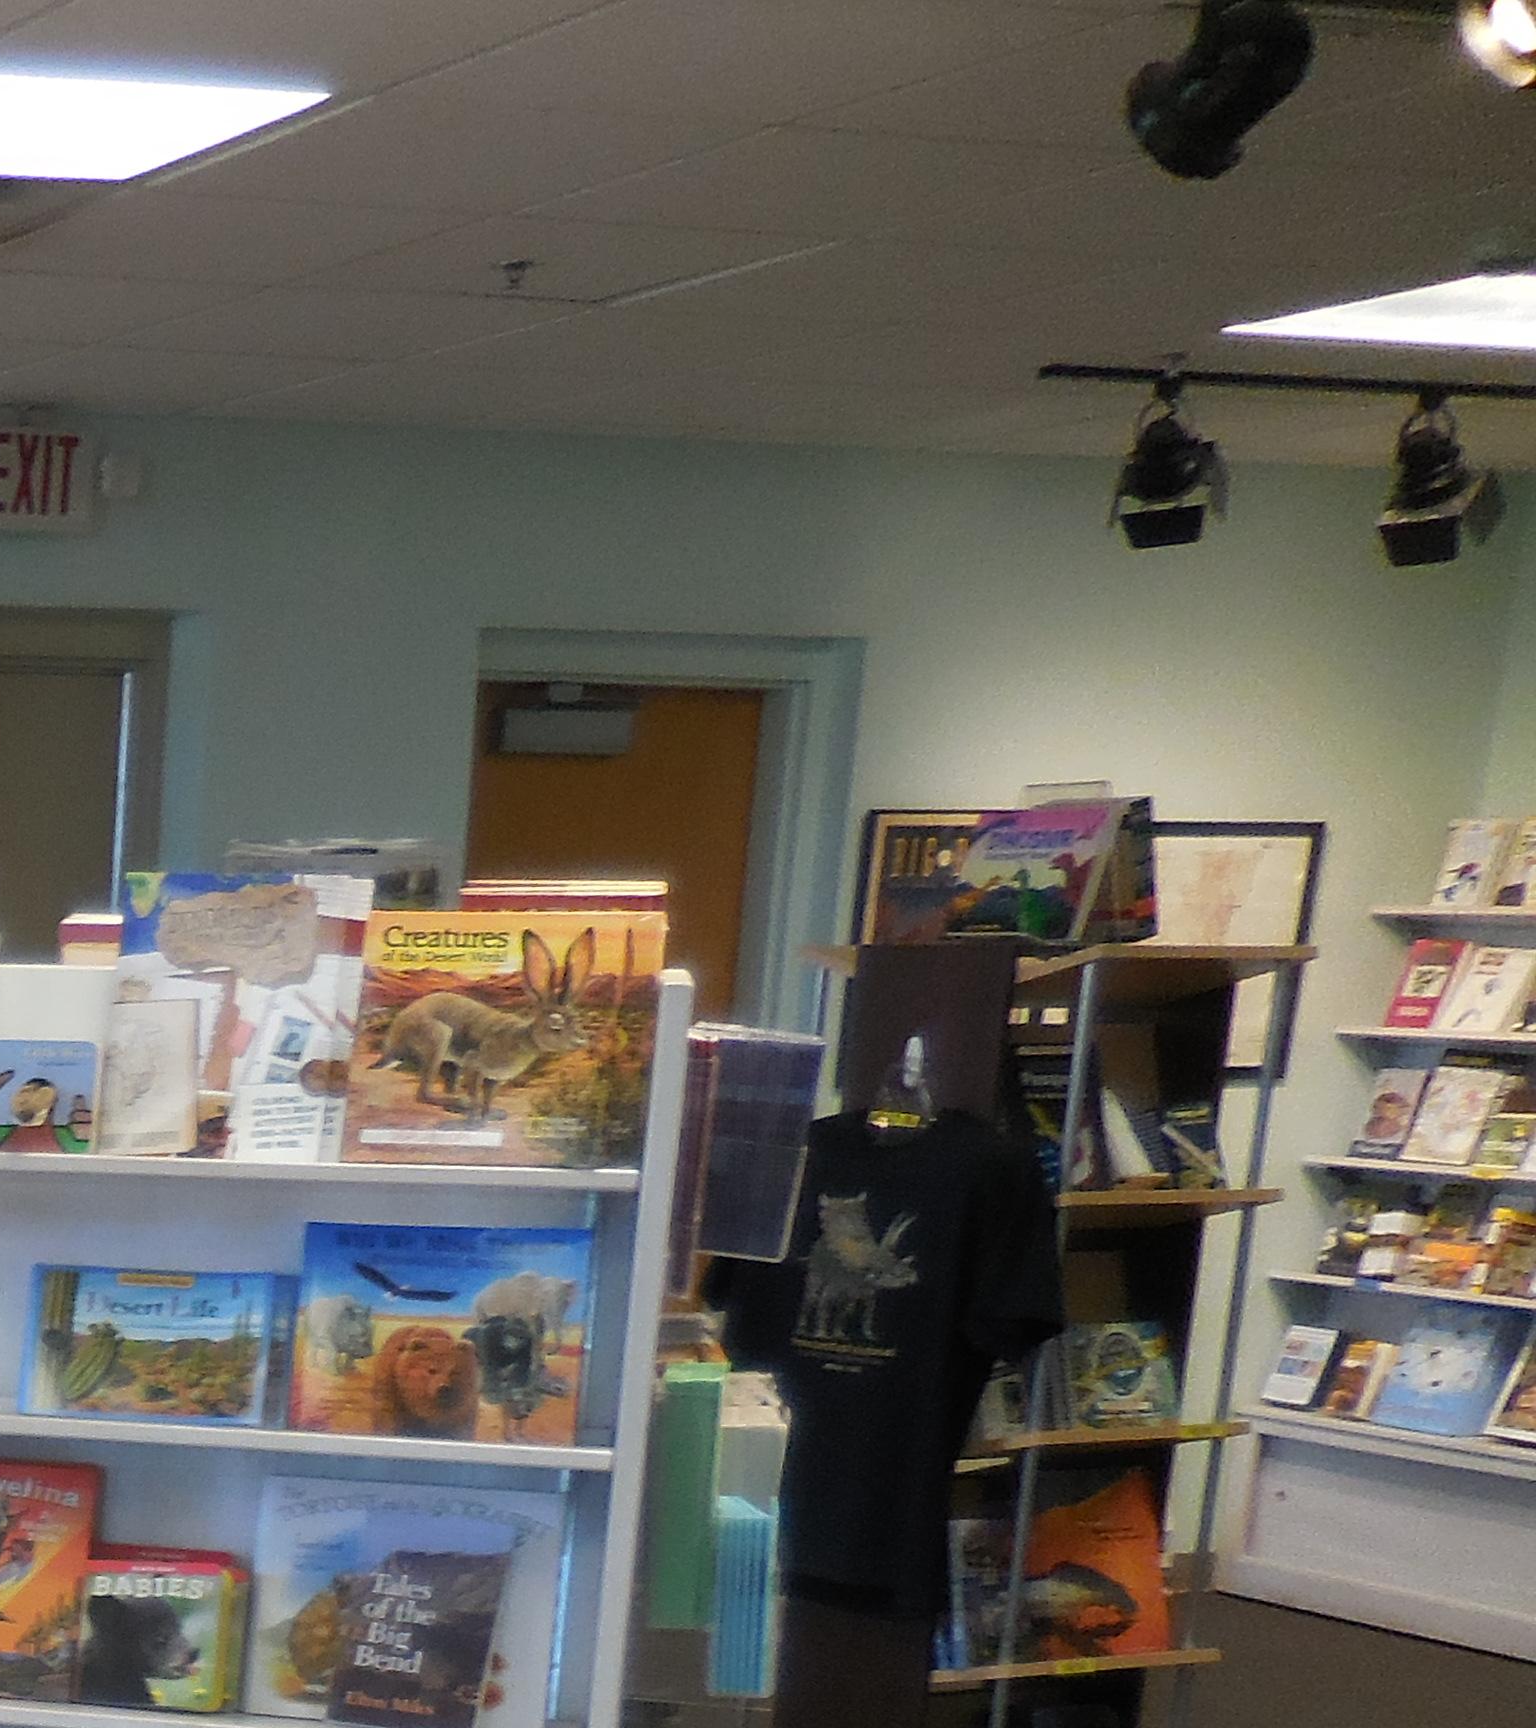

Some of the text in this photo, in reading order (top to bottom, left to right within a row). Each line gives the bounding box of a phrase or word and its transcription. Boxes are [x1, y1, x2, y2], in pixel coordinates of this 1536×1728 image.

[382, 924, 511, 950] Creatures
[381, 950, 508, 964] of the Desert World
[86, 1291, 164, 1317] Desert
[371, 1573, 433, 1601] Tales
[361, 1597, 437, 1625] of the
[366, 1621, 414, 1654] Big
[353, 1645, 424, 1674] Bend
